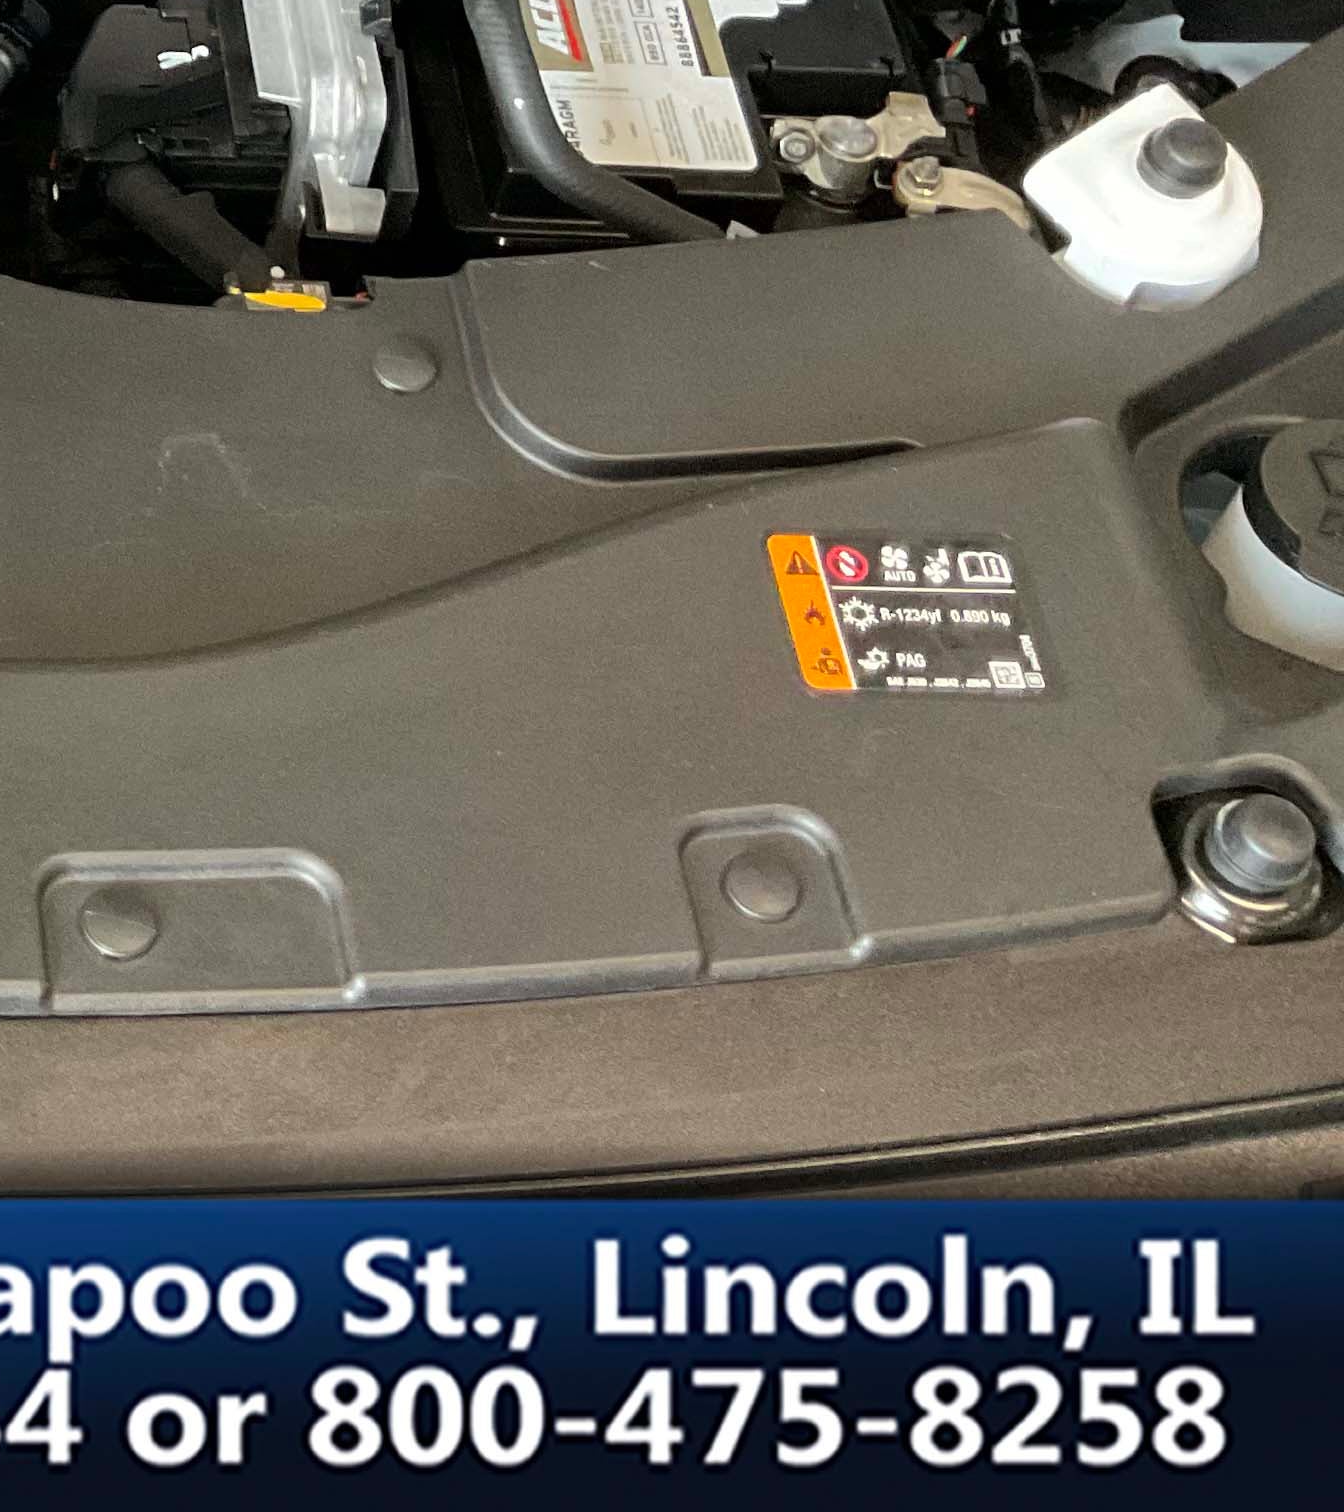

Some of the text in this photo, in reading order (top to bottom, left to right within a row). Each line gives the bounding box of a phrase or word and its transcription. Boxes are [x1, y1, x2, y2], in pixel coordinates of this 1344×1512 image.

[884, 570, 917, 583] AUTO
[991, 610, 1011, 627] kg
[895, 652, 927, 669] PAG
